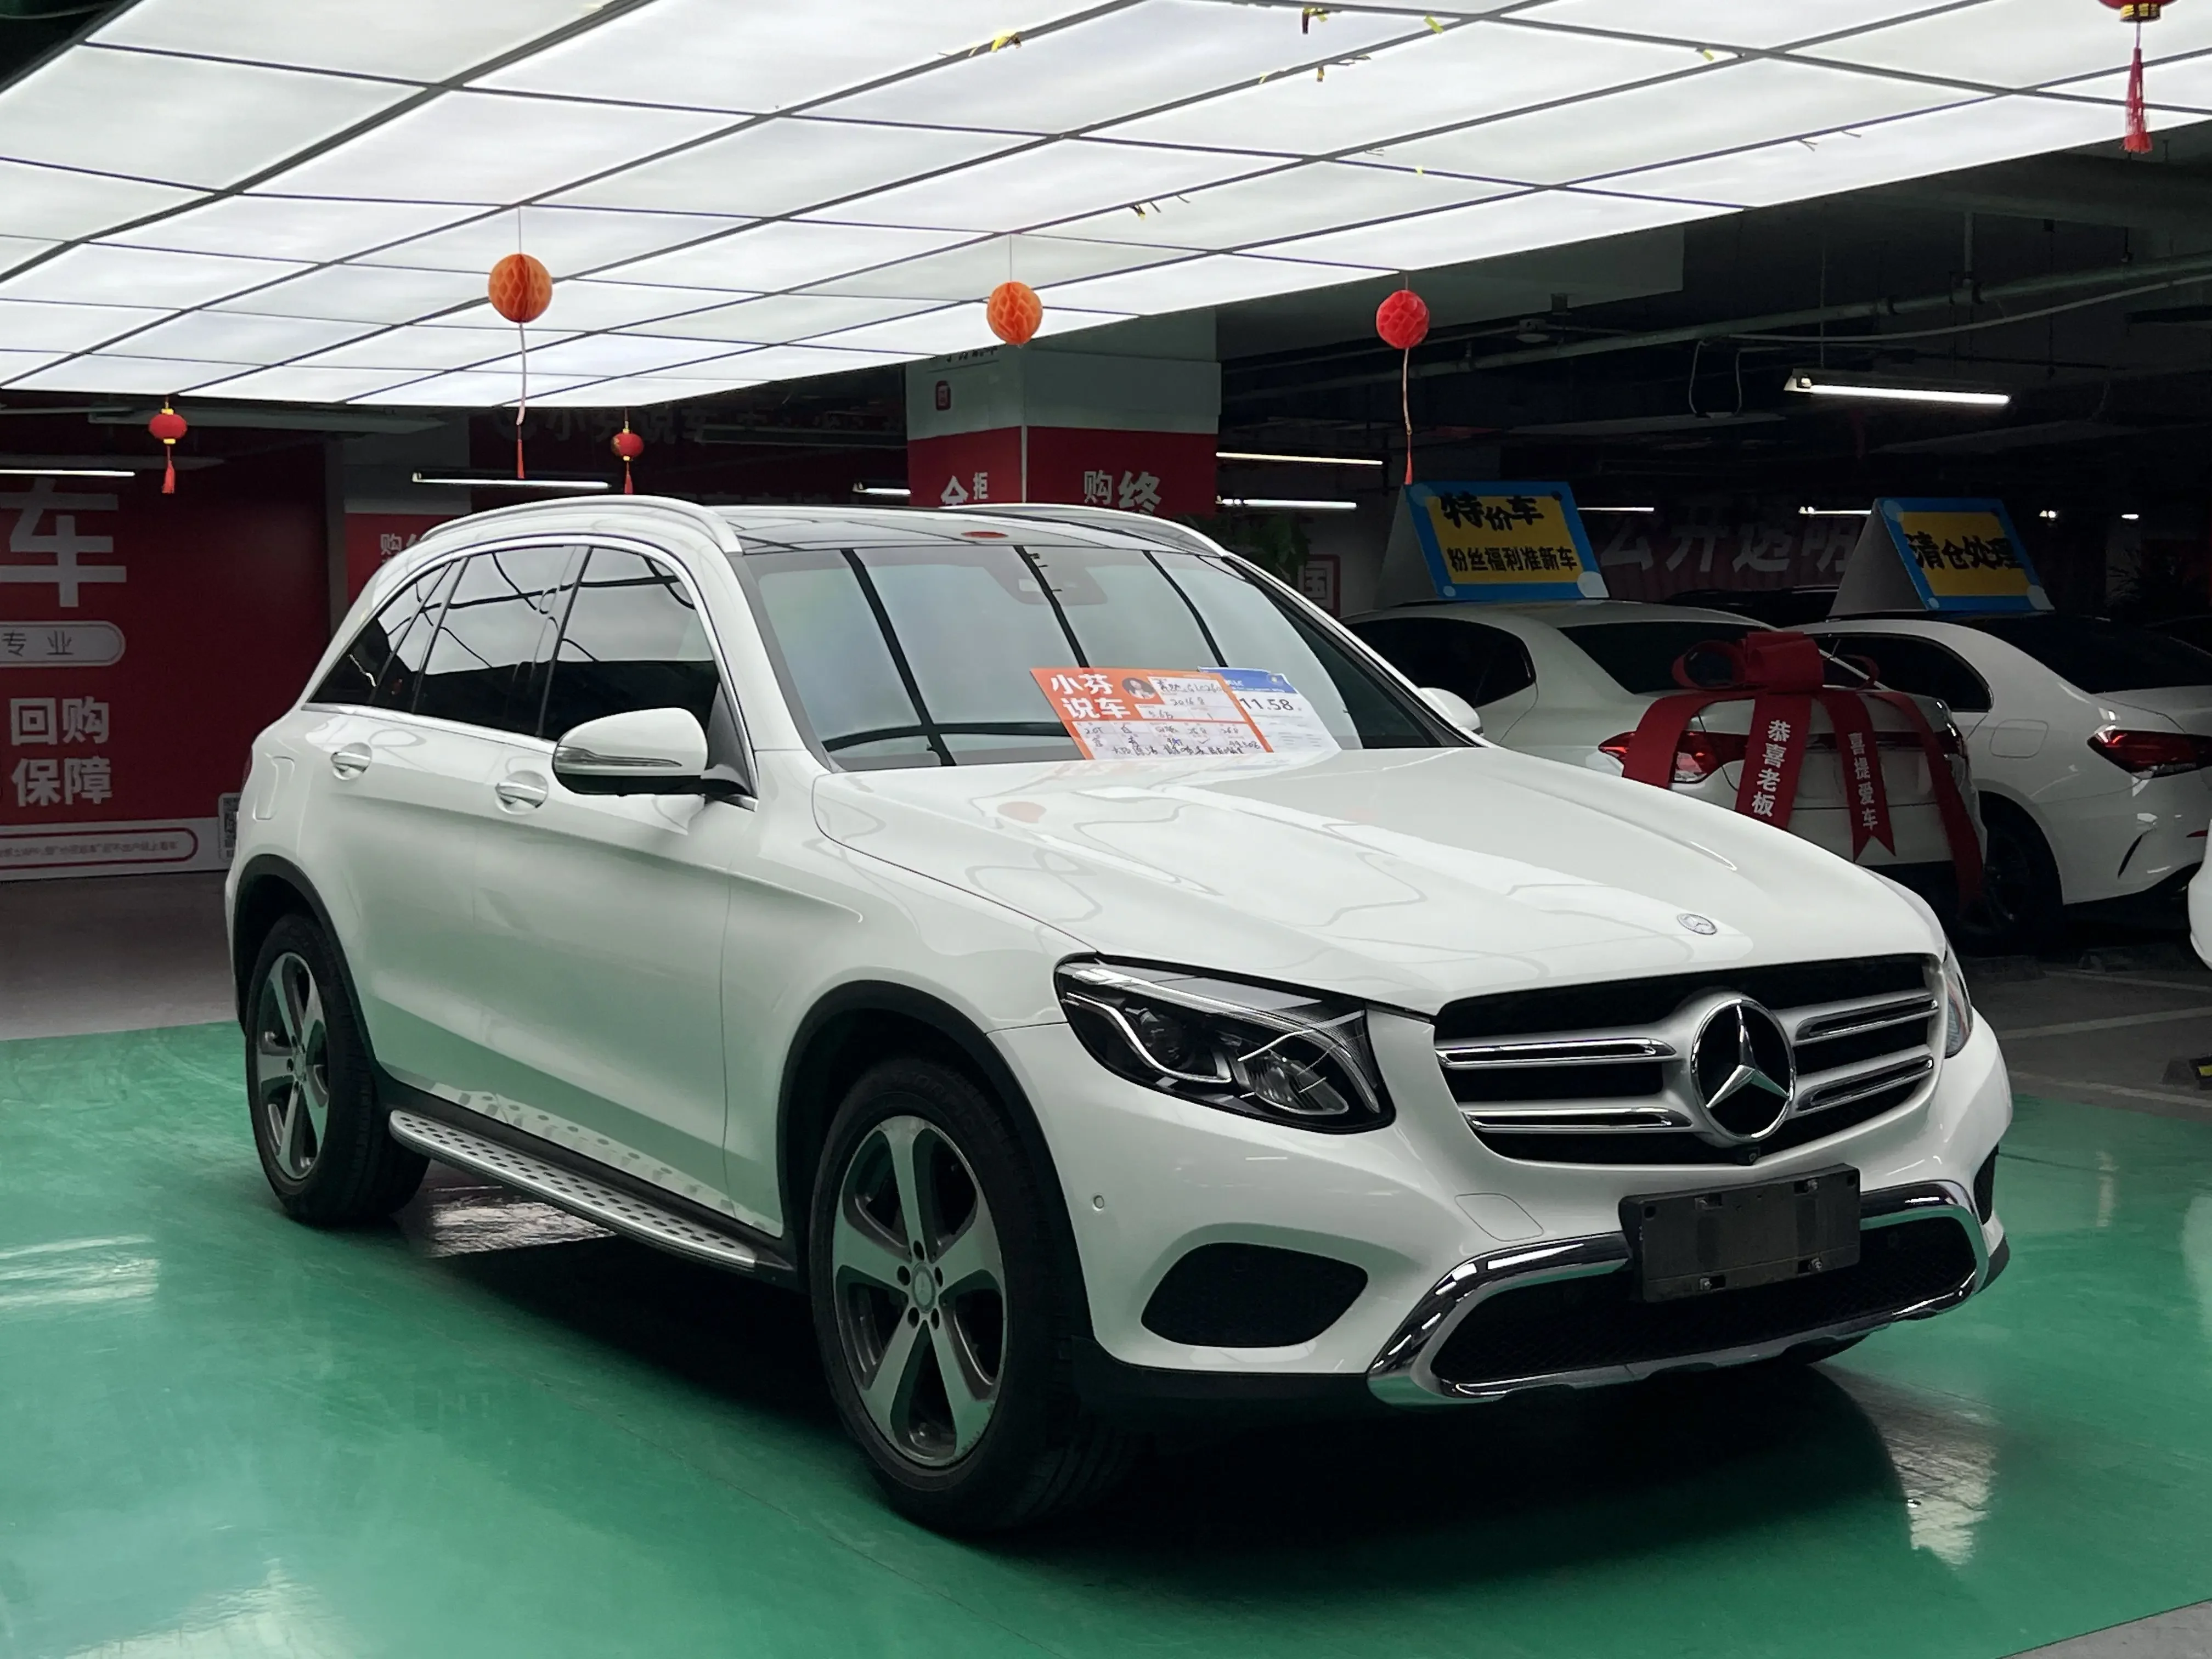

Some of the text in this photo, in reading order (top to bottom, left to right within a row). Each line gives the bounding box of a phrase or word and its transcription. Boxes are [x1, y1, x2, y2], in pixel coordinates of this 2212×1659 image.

[1440, 490, 1544, 531] 特价车
[0, 476, 127, 607] 车
[1447, 546, 1578, 572] 粉丝福利准新车
[1904, 531, 2024, 571] 清仓处理
[1051, 673, 1114, 695] 小芬
[1240, 697, 1295, 711] 11.58
[10, 696, 110, 746] 回购
[1062, 698, 1131, 720] 说车
[12, 757, 113, 807] 保障
[1752, 720, 1791, 817] 恭喜老板
[1848, 732, 1878, 831] 喜提爱车
